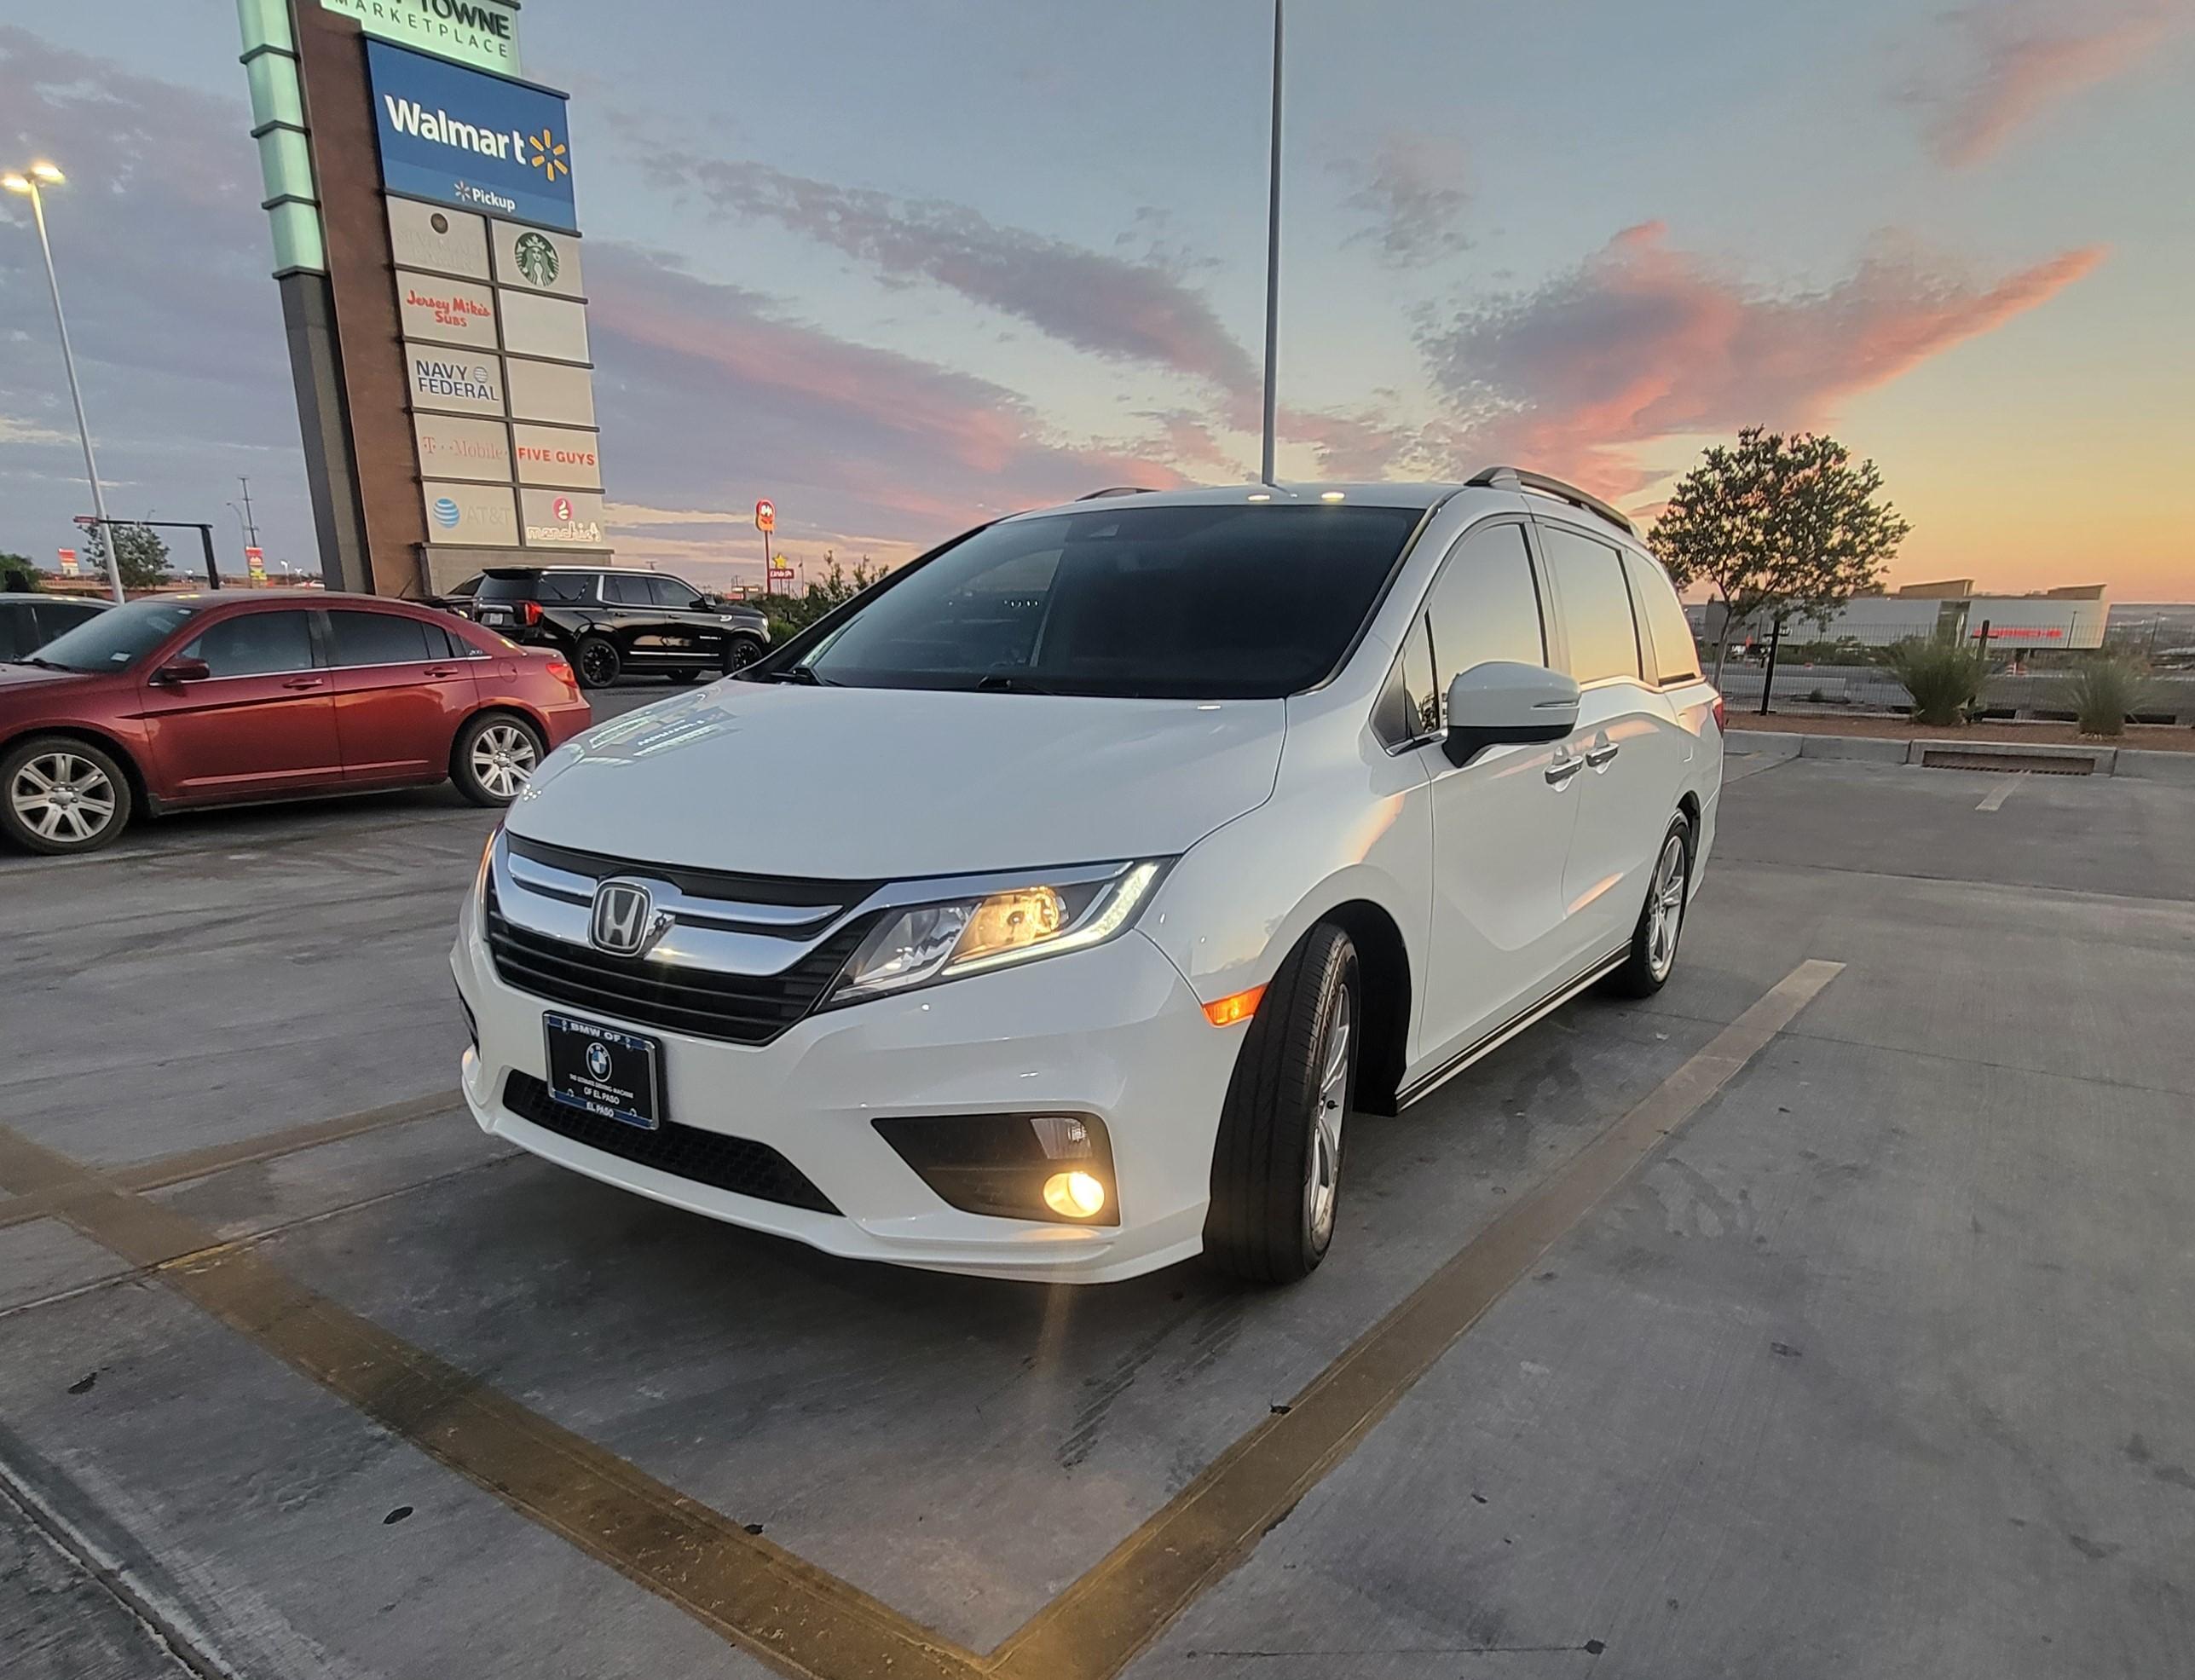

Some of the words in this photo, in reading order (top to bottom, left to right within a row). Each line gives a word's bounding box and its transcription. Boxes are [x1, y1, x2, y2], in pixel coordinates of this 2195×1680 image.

[384, 95, 527, 165] Walmart
[472, 188, 516, 211] Pickup
[407, 289, 450, 315] Jersey
[453, 297, 491, 317] Mike's
[416, 360, 468, 381] NAVY
[418, 377, 500, 401] FEDERAL
[518, 447, 551, 462] FIVE
[556, 451, 595, 466] GUYS
[465, 505, 511, 526] AT&T
[571, 1023, 601, 1037] BMW
[604, 1031, 621, 1042] OF
[593, 1089, 602, 1100] EL
[602, 1092, 620, 1105] PASO
[586, 1101, 596, 1112] EL
[596, 1104, 614, 1117] PASO
